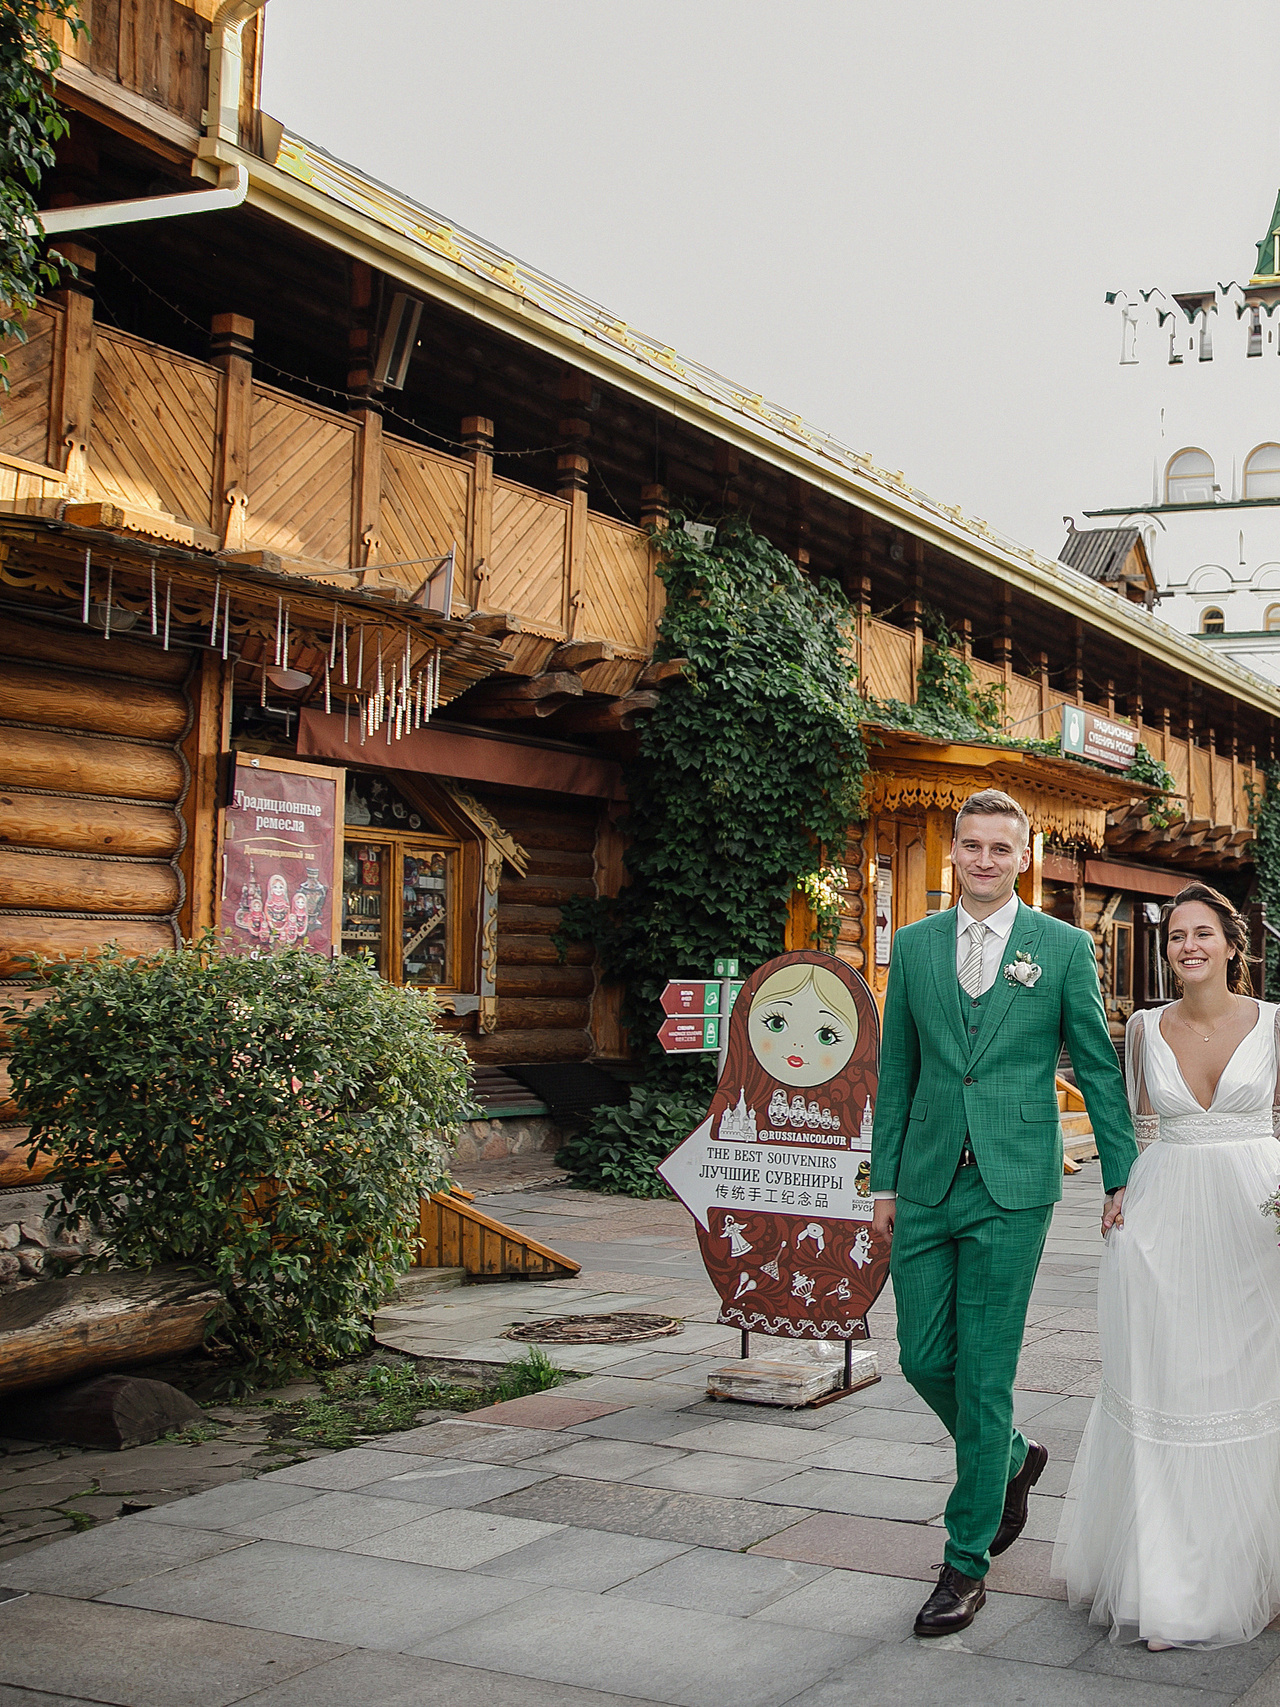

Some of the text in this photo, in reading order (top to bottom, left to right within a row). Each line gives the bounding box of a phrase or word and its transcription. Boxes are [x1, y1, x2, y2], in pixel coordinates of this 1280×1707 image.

[1088, 731, 1115, 750] СУВЕНИРЫ
[1093, 718, 1134, 743] ТРАДИЦИОННЫЕ
[234, 789, 322, 817] Традиционные
[255, 815, 305, 833] ремесла
[758, 1129, 848, 1146] @RUSSIANCOLOUR
[706, 1147, 838, 1170] THE BEST SOUVENIRS
[698, 1164, 844, 1191] ЛУЧШИЕ СУВЕНИРЫ
[714, 1183, 830, 1209] 传统手工纪念品
